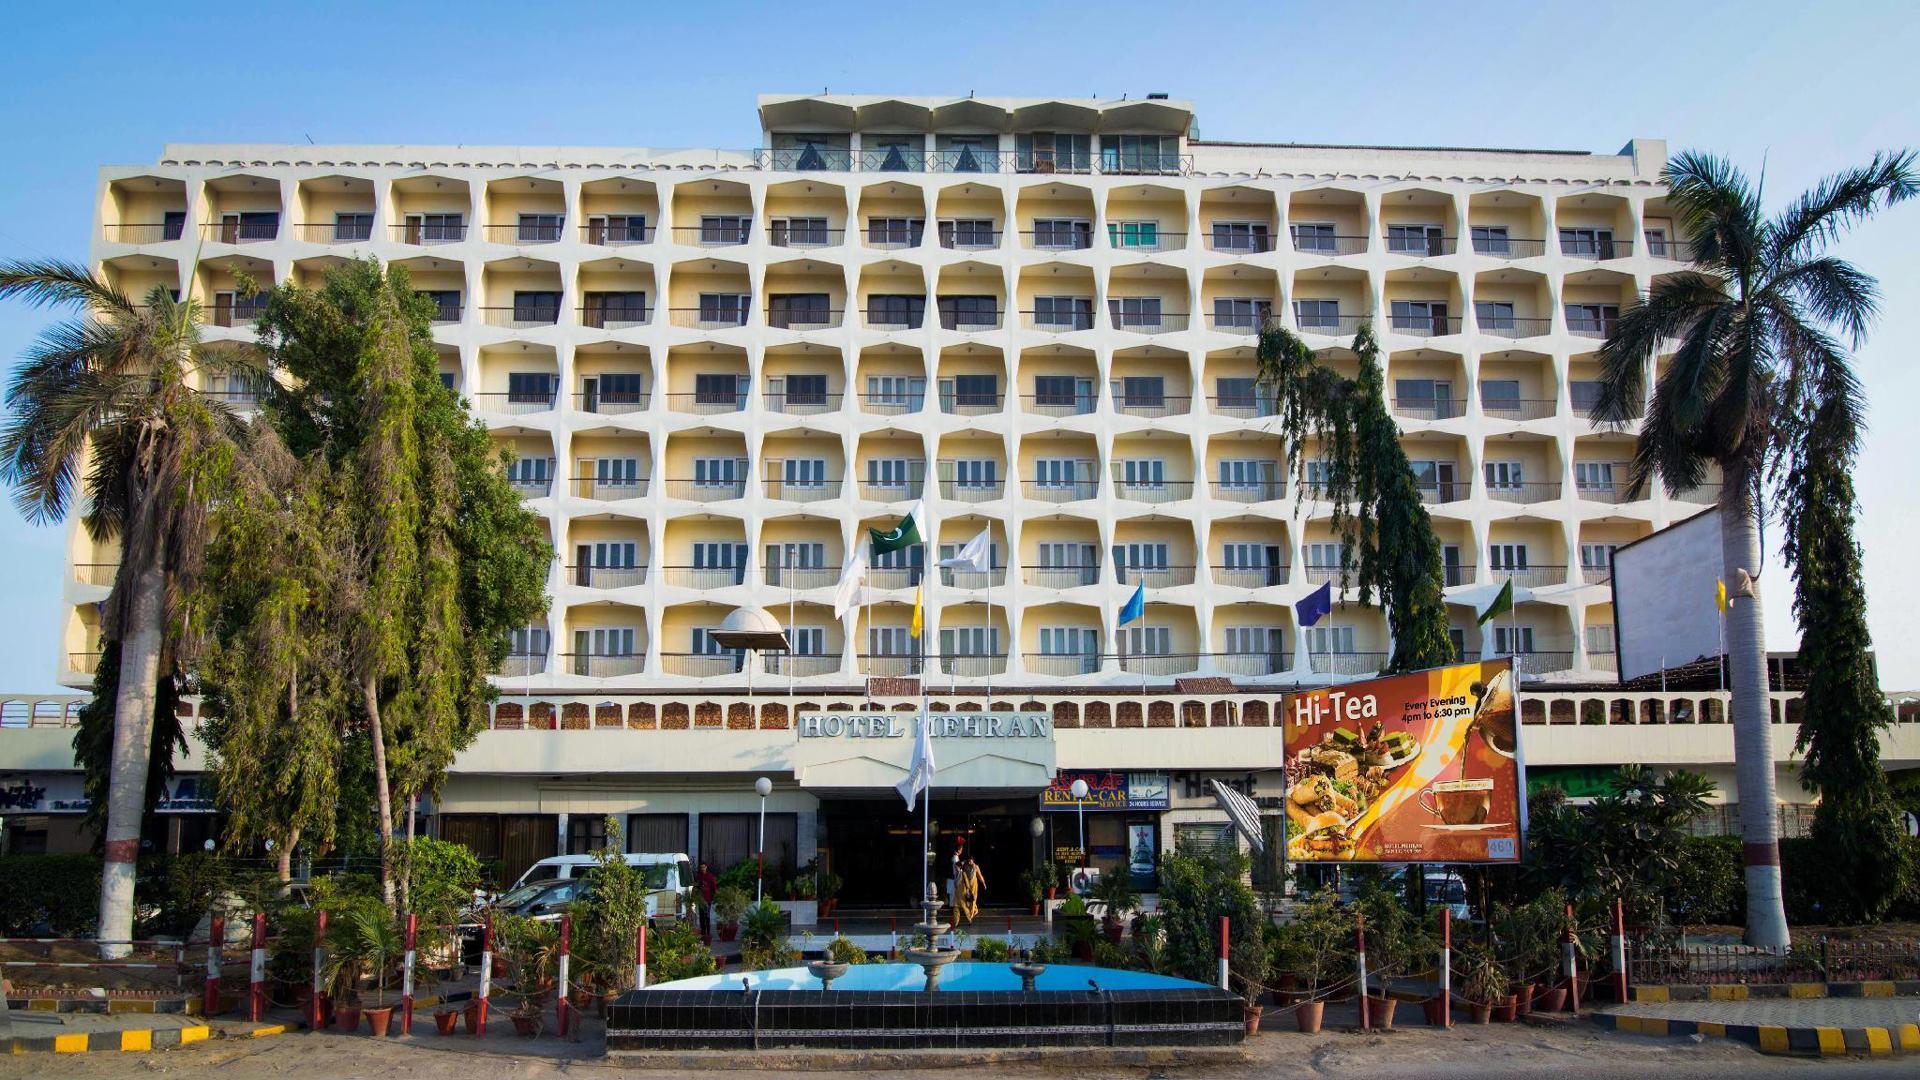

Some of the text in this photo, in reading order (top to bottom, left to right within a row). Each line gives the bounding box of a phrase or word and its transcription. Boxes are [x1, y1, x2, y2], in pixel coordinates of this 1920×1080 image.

[1295, 691, 1378, 727] Hi-Tea
[1405, 695, 1466, 710] Every Evening
[1402, 707, 1471, 723] 4pm to 6:30 pm
[802, 715, 906, 738] HOTEL
